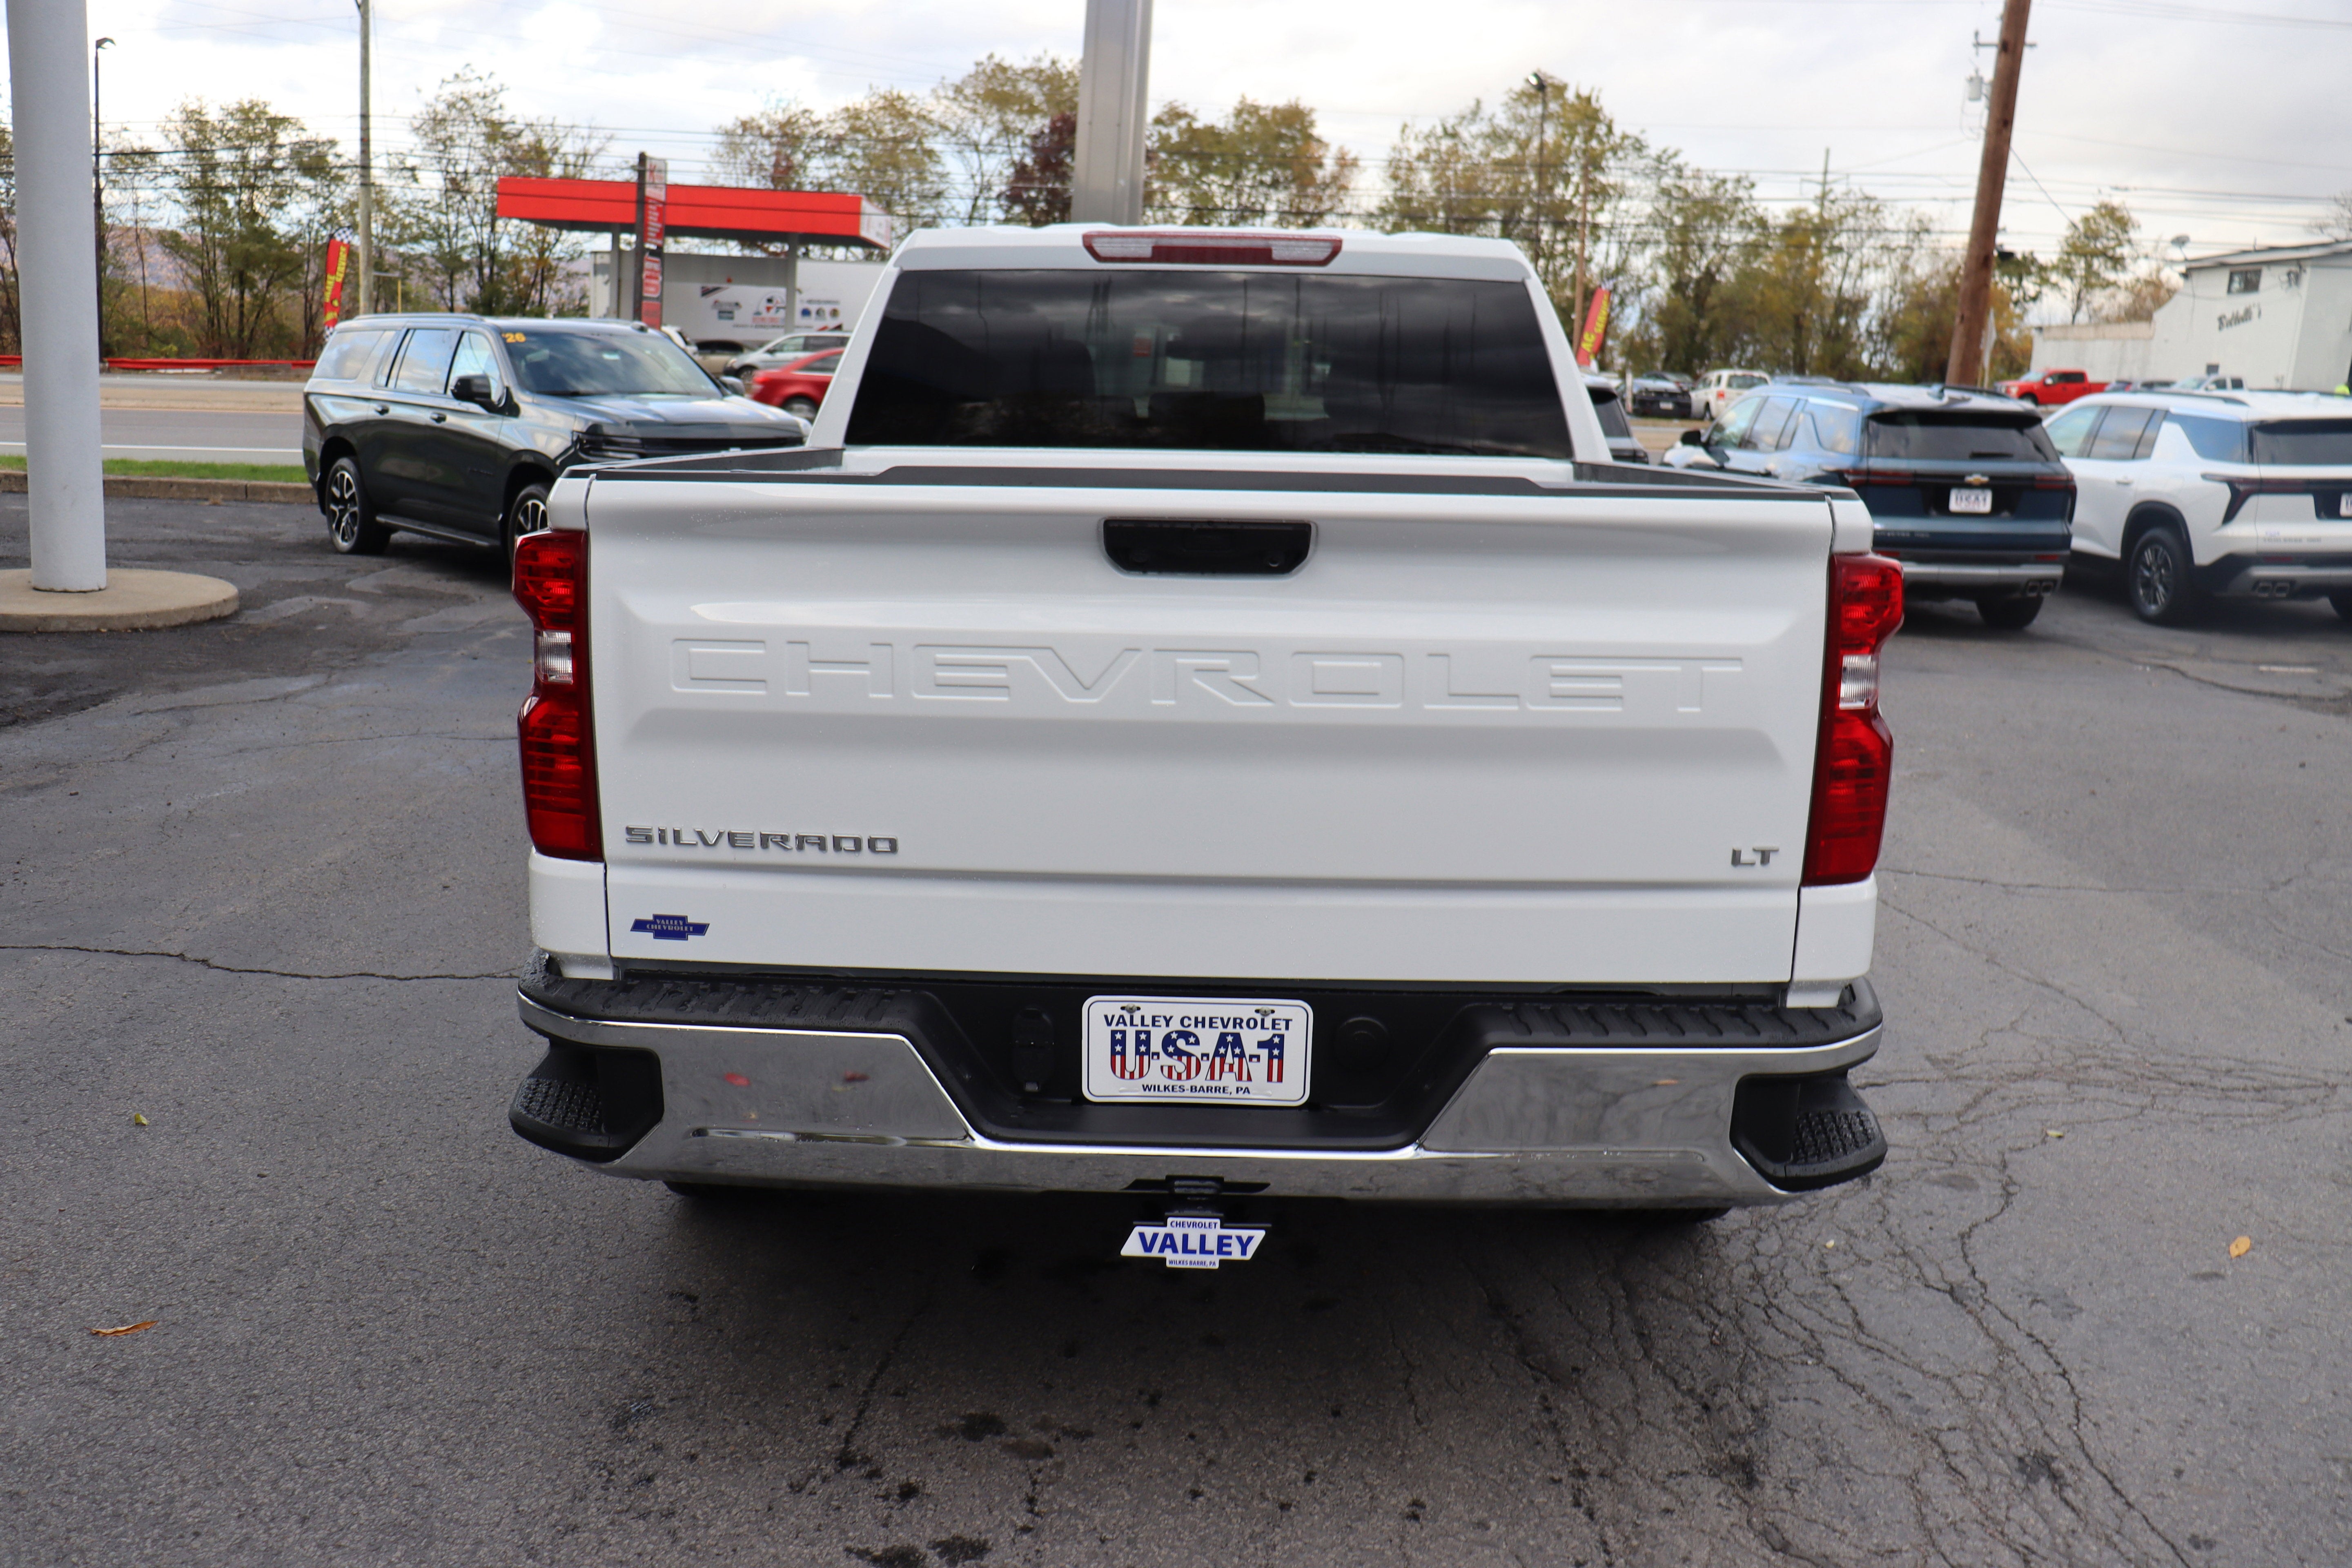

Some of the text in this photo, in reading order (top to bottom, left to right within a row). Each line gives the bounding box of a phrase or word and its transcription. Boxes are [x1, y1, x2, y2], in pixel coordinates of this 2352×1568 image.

[1581, 331, 1596, 352] AC
[671, 638, 1743, 713] CHEVROLET
[626, 825, 898, 853] SILVERADO
[1731, 845, 1779, 866] LT
[1104, 1014, 1293, 1031] VALLEY CHEVROLET
[1142, 1084, 1232, 1096] WILKES-BARRE,
[1170, 1220, 1218, 1229] CHEVROLET
[1138, 1232, 1255, 1257] VALLEY
